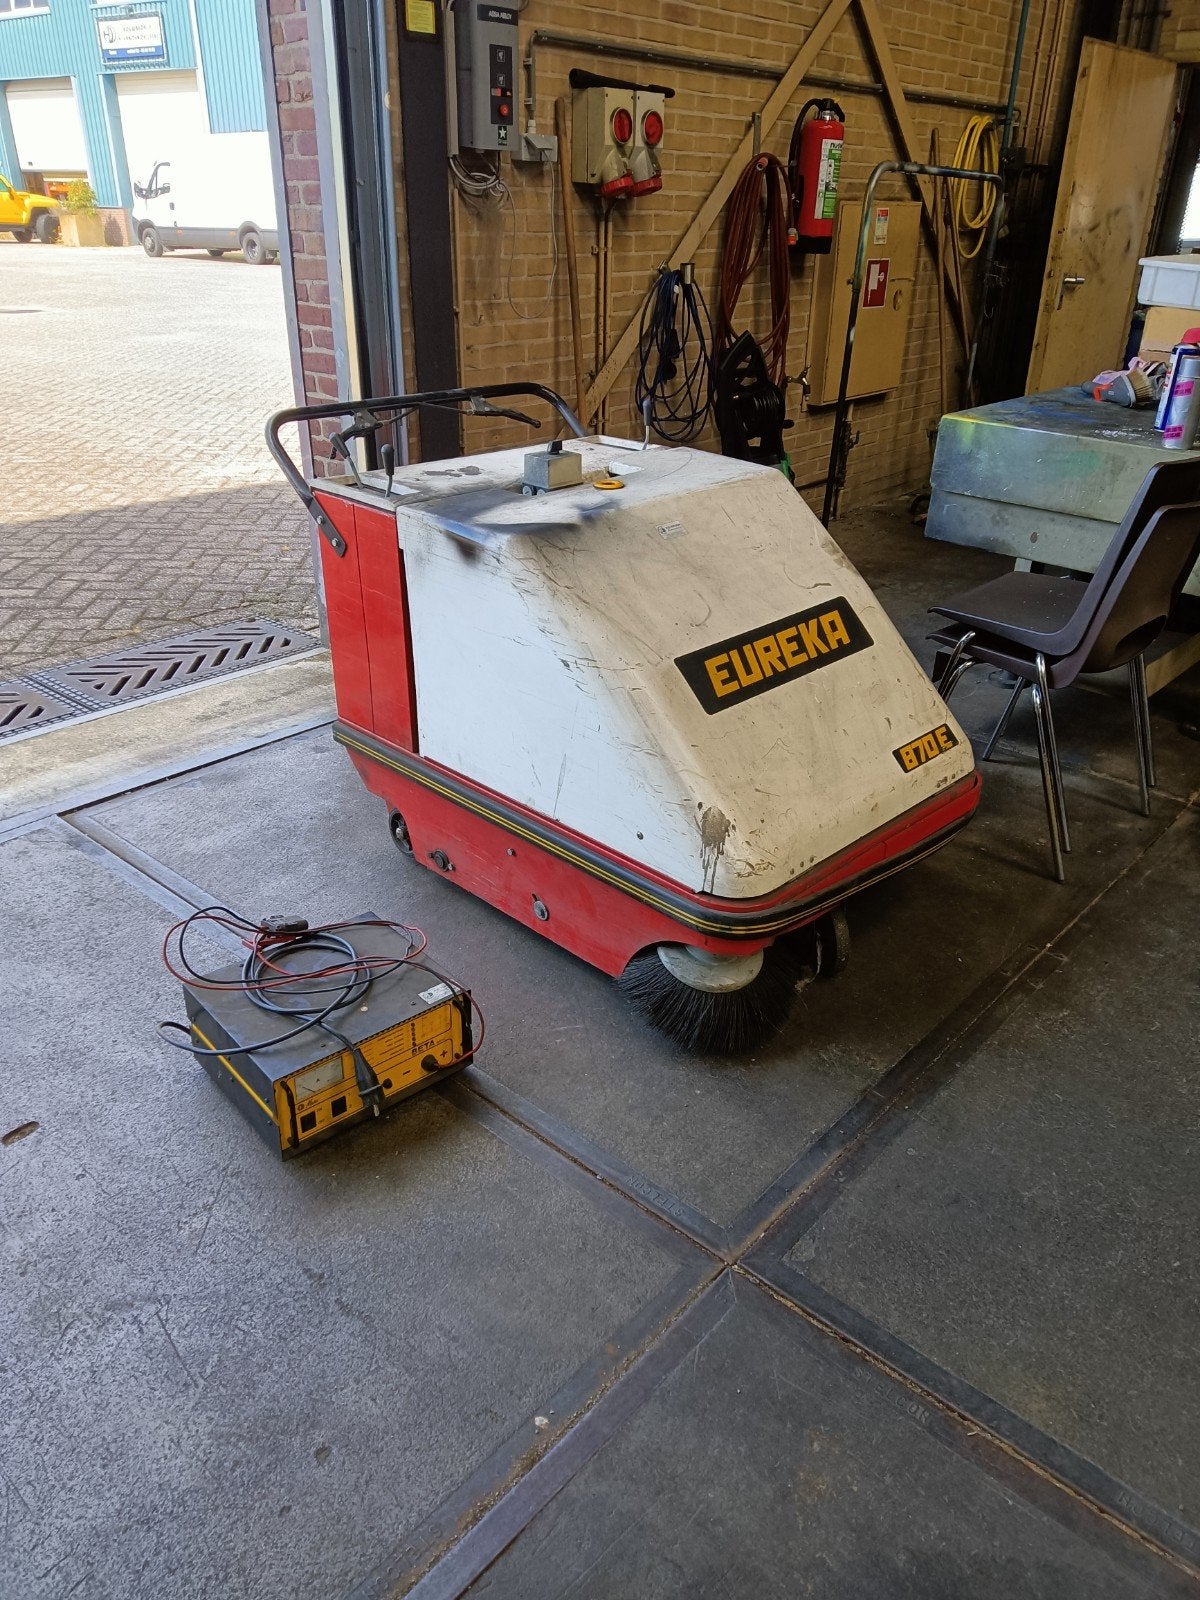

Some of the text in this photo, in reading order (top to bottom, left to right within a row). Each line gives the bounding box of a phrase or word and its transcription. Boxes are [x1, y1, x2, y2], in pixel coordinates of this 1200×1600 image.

[704, 609, 851, 699] EUREKA
[899, 725, 951, 771] 870 E
